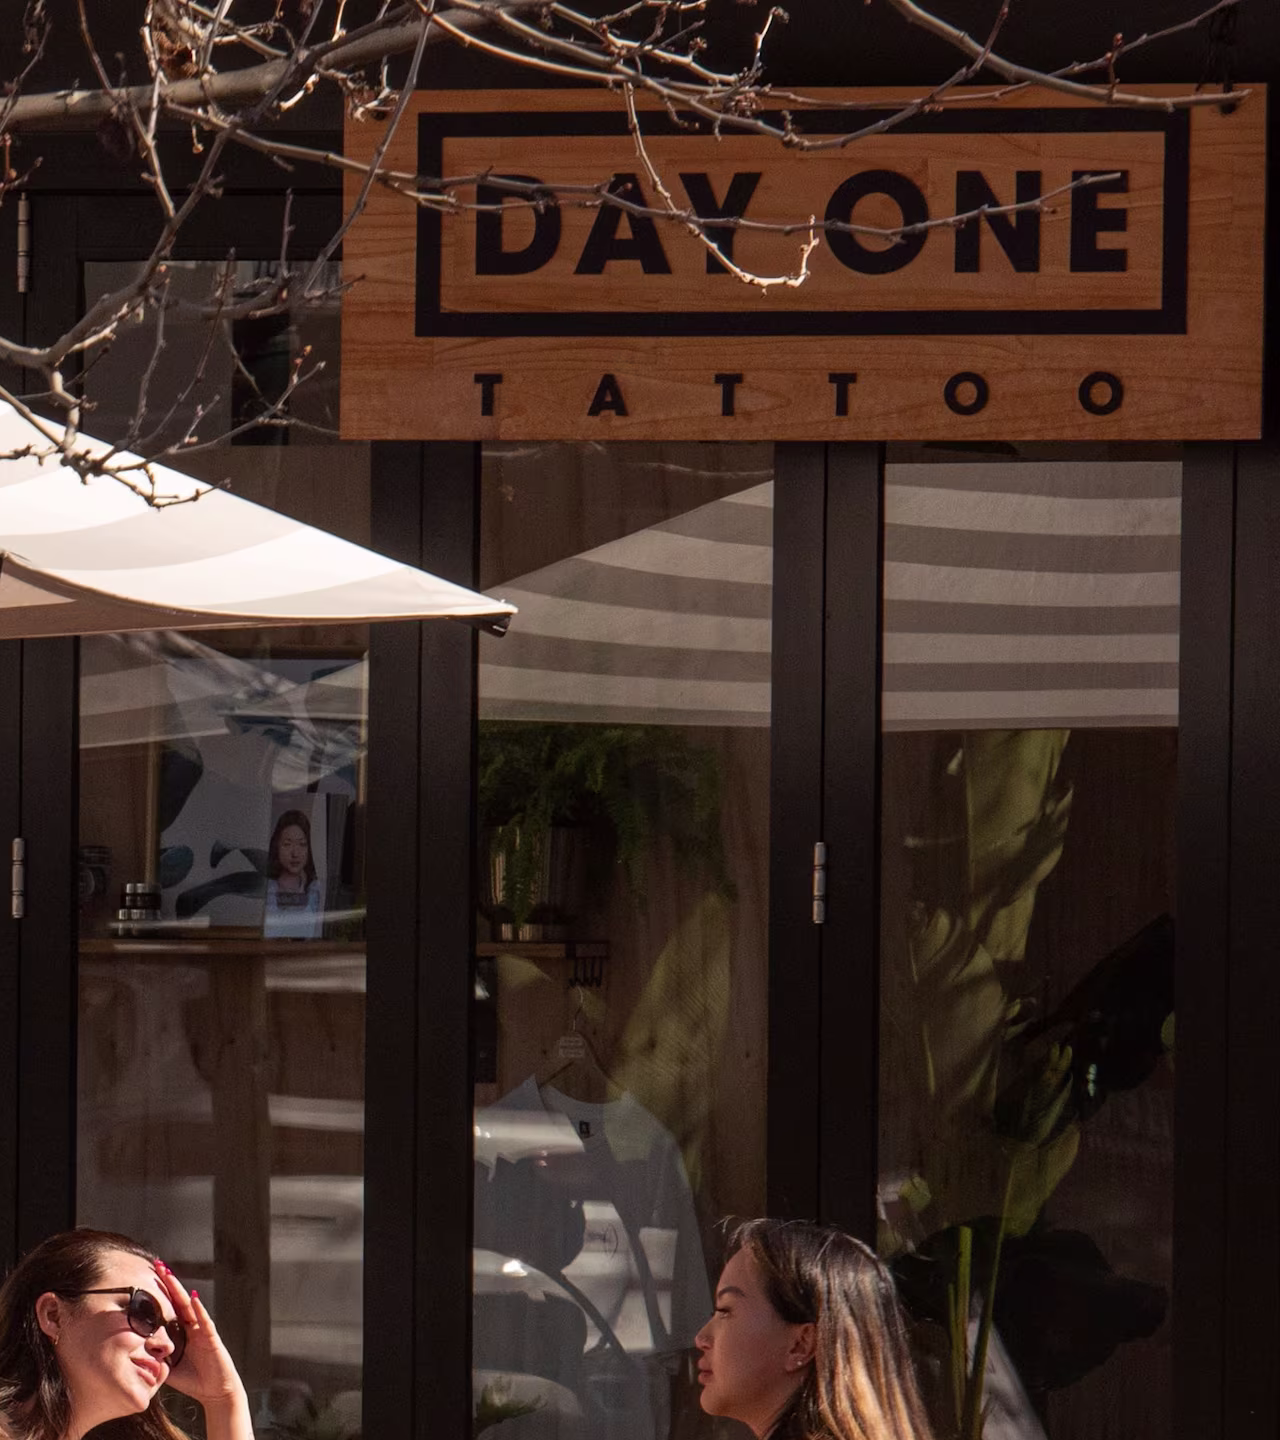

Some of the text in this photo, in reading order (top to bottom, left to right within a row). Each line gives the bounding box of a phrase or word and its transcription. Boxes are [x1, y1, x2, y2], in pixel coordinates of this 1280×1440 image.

[474, 169, 1130, 276] DAY ONE
[473, 371, 1125, 418] TATTOO
